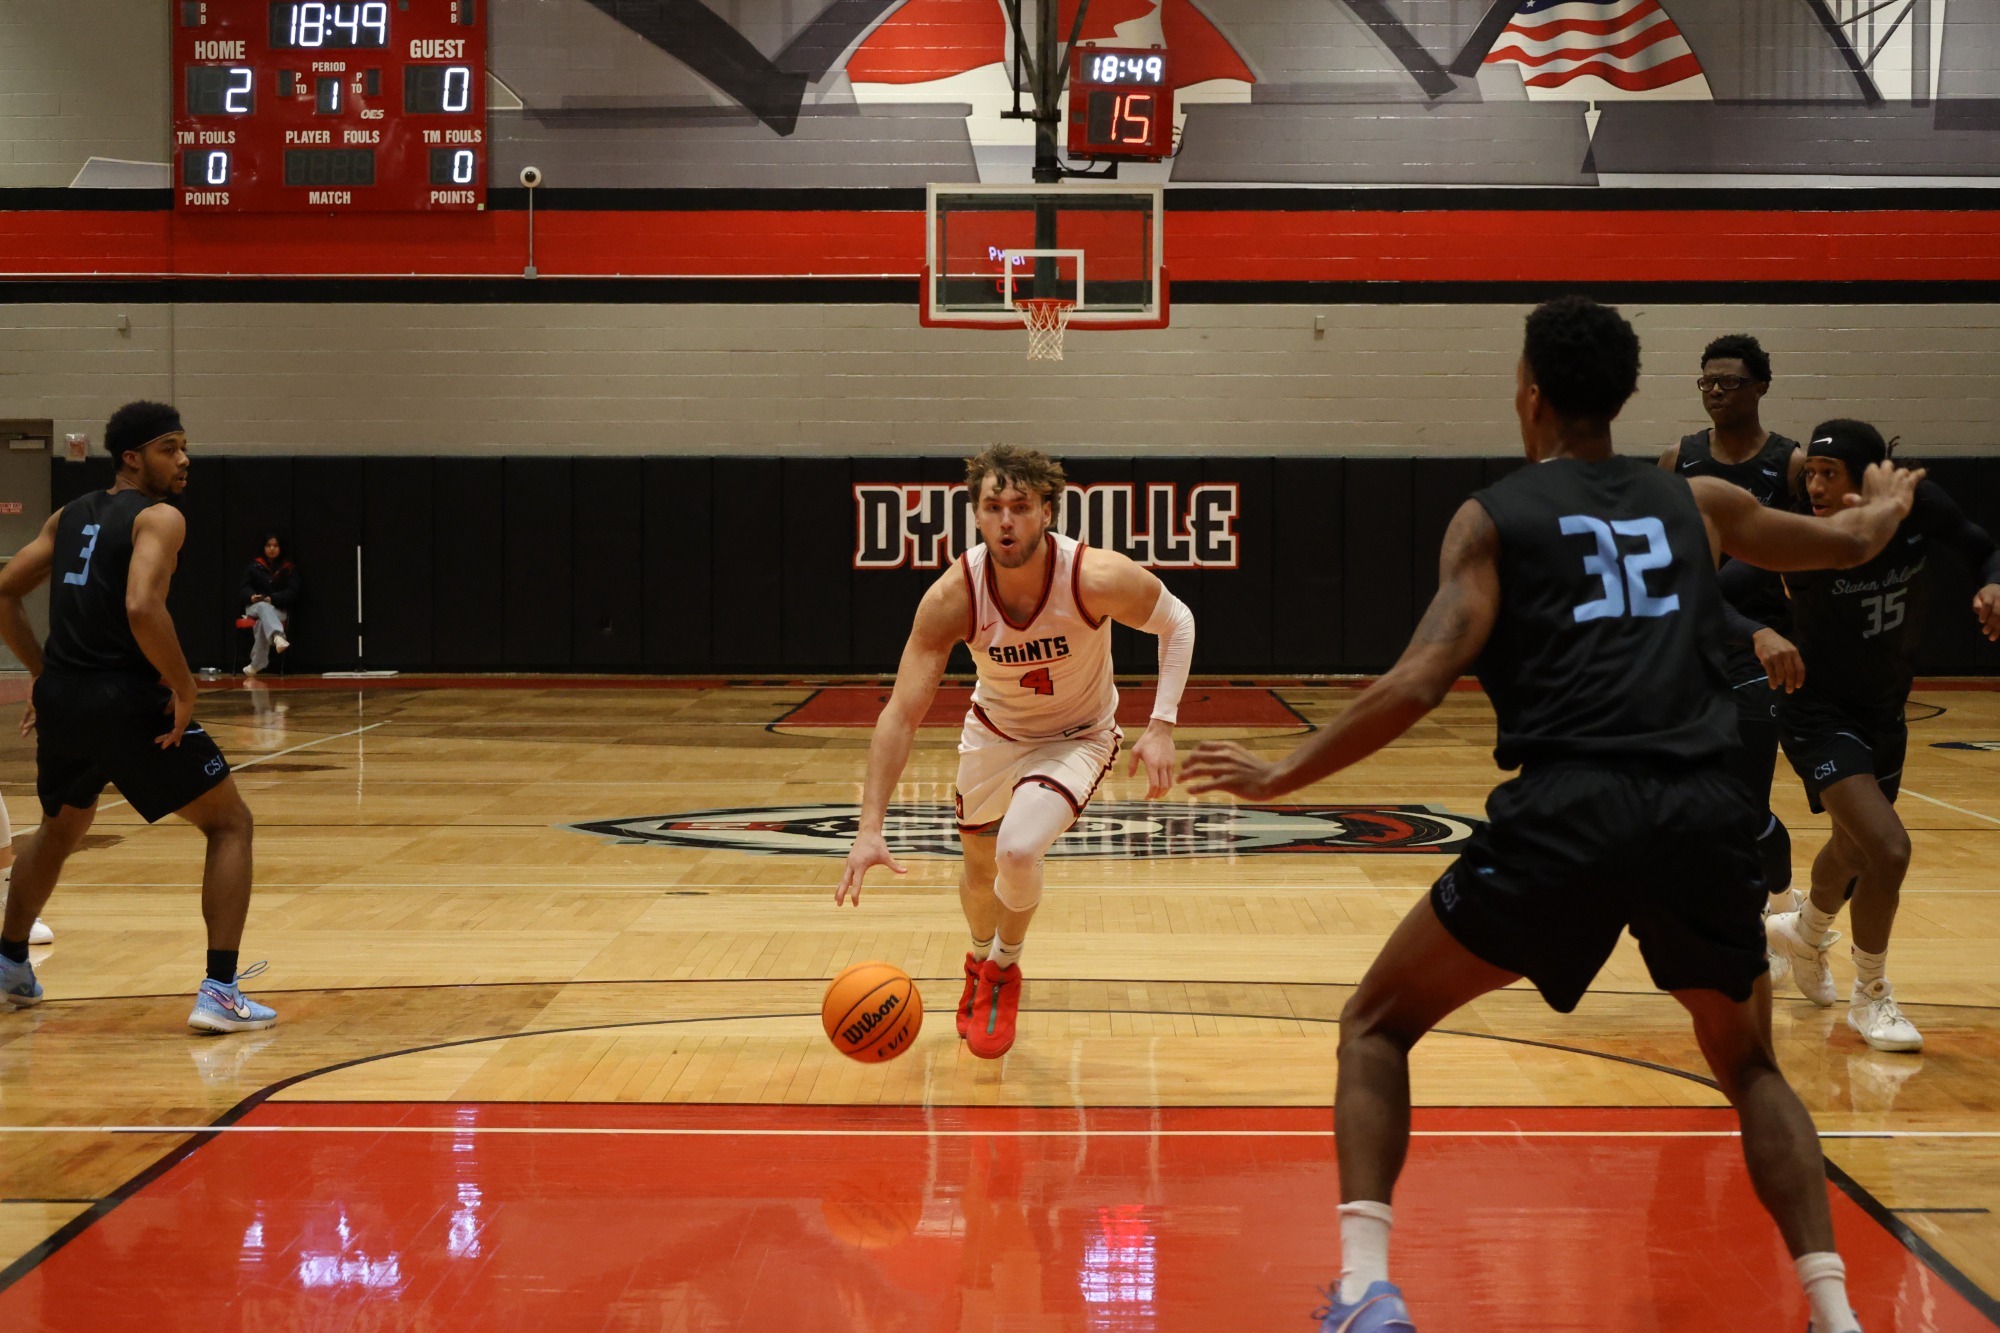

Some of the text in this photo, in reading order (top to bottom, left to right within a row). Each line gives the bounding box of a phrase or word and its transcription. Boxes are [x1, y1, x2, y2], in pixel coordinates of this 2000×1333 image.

[201, 3, 207, 13] B
[451, 2, 457, 12] B
[201, 15, 207, 25] B
[290, 3, 387, 46] 18:49
[451, 14, 457, 24] B
[195, 41, 246, 60] HOME
[410, 39, 466, 59] GUEST
[295, 72, 302, 82] P
[312, 62, 346, 73] PERIOD
[356, 72, 363, 82] P
[1093, 55, 1162, 83] 18:49
[226, 68, 252, 113] 2
[295, 84, 307, 94] TO
[332, 81, 339, 110] 1
[351, 83, 363, 94] TO
[443, 67, 470, 112] 0
[1110, 94, 1150, 144] 15
[177, 130, 236, 144] TM FOULS
[285, 130, 380, 144] PLAYER FOULS
[423, 129, 482, 143] TM FOULS
[207, 151, 228, 185] 0
[453, 150, 474, 184] 0
[185, 192, 230, 206] POINTS
[309, 191, 351, 205] MATCH
[430, 190, 475, 204] POINTS
[63, 523, 101, 587] 3
[1558, 514, 1681, 623] 32
[1832, 579, 1879, 595] Staten
[1861, 587, 1908, 639] 35
[1019, 667, 1055, 696] 4
[204, 754, 224, 776] CSI
[1814, 760, 1837, 780] CSI
[841, 994, 900, 1045] Wilson
